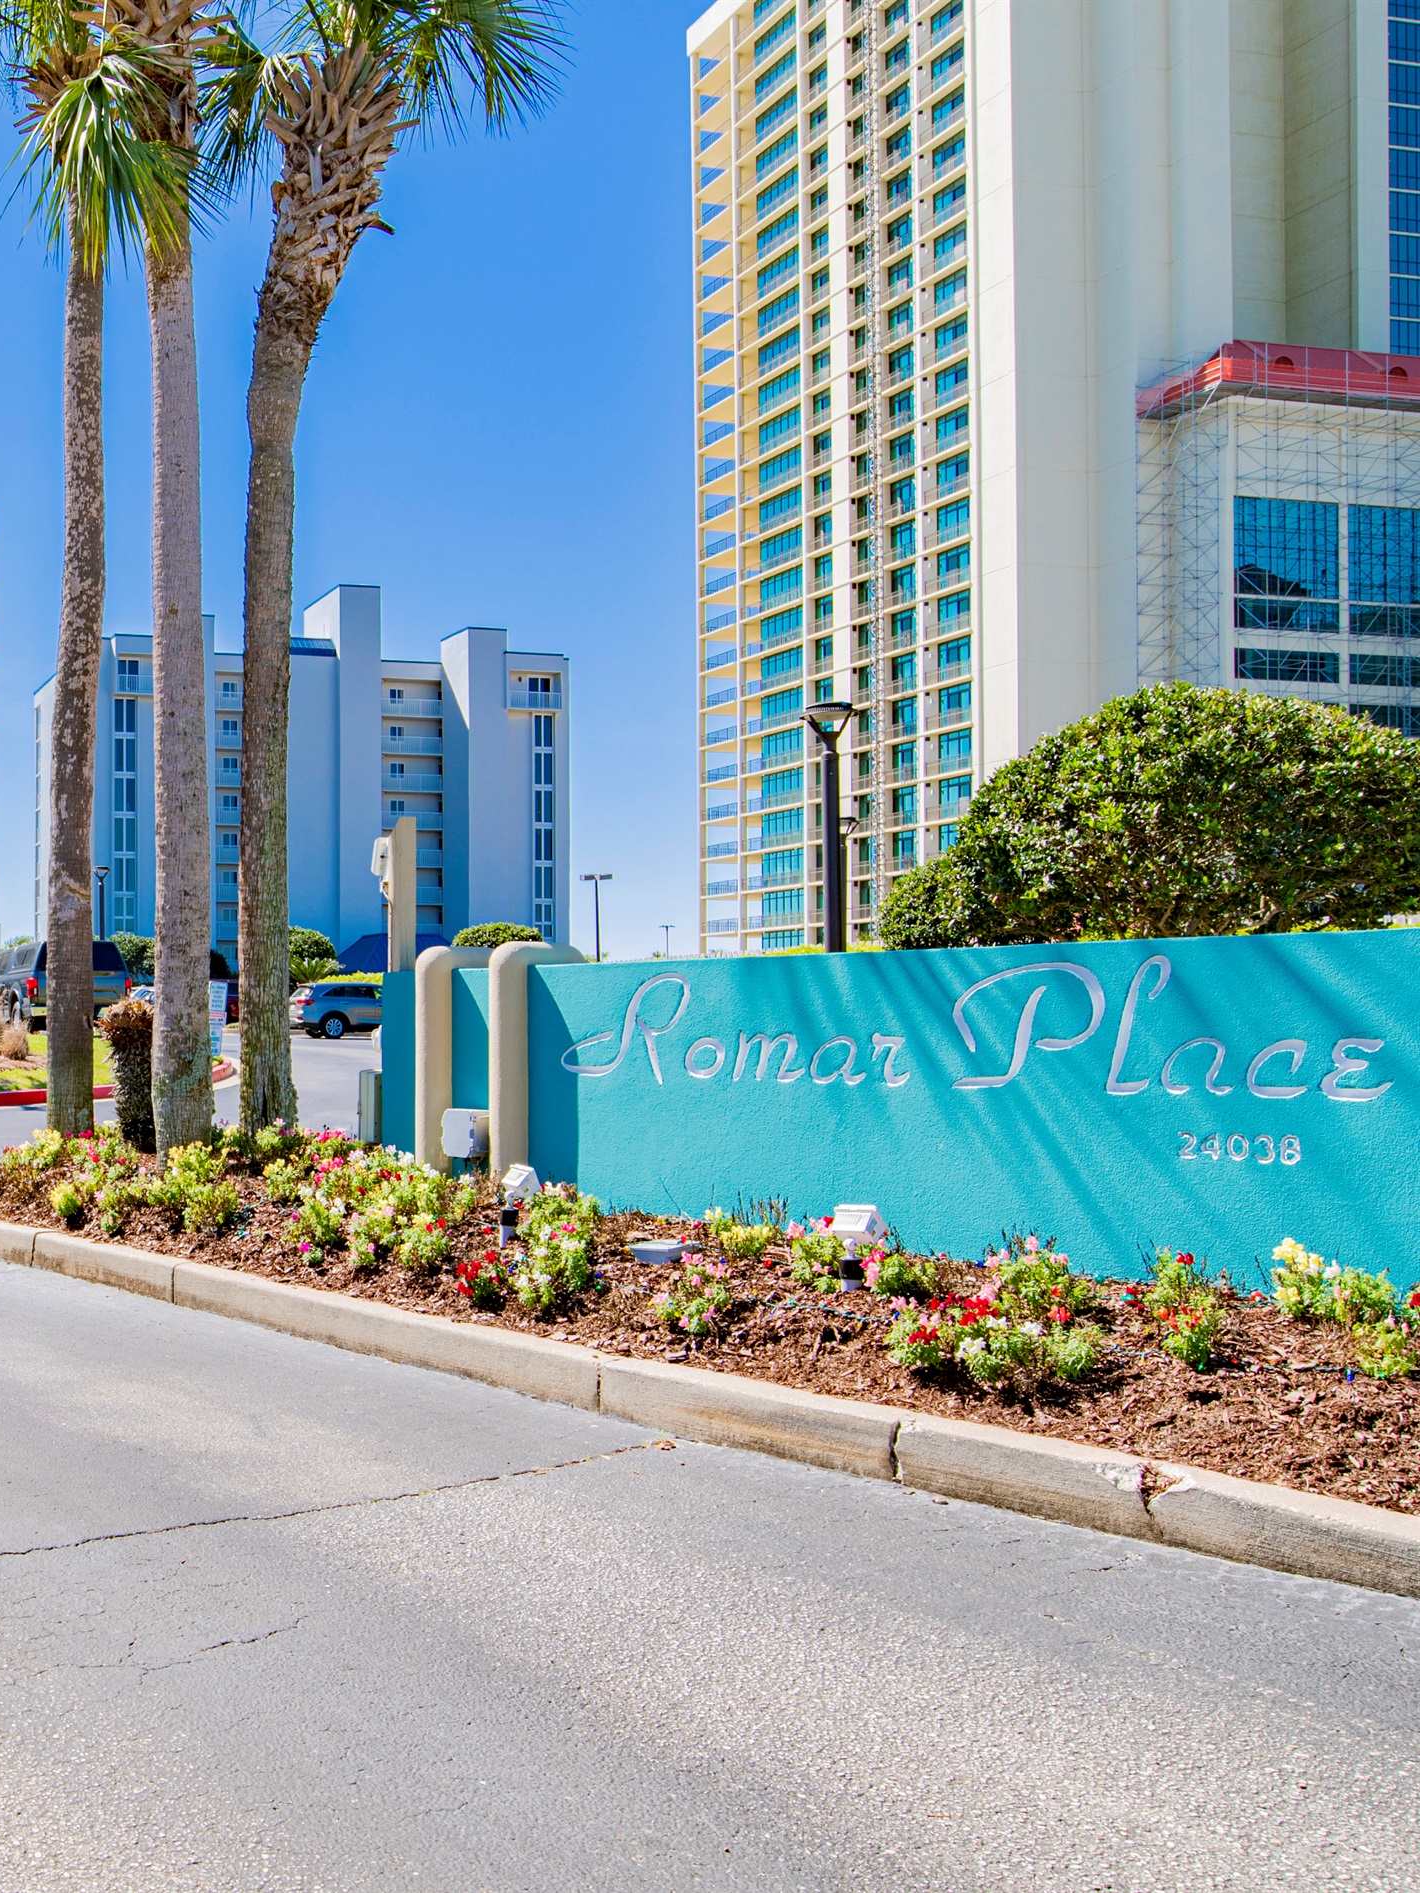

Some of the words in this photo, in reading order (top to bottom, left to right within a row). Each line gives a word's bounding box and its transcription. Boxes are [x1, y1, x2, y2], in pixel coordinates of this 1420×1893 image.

[561, 972, 911, 1087] Romar
[952, 955, 1394, 1102] Place
[1178, 1131, 1301, 1165] 24038
